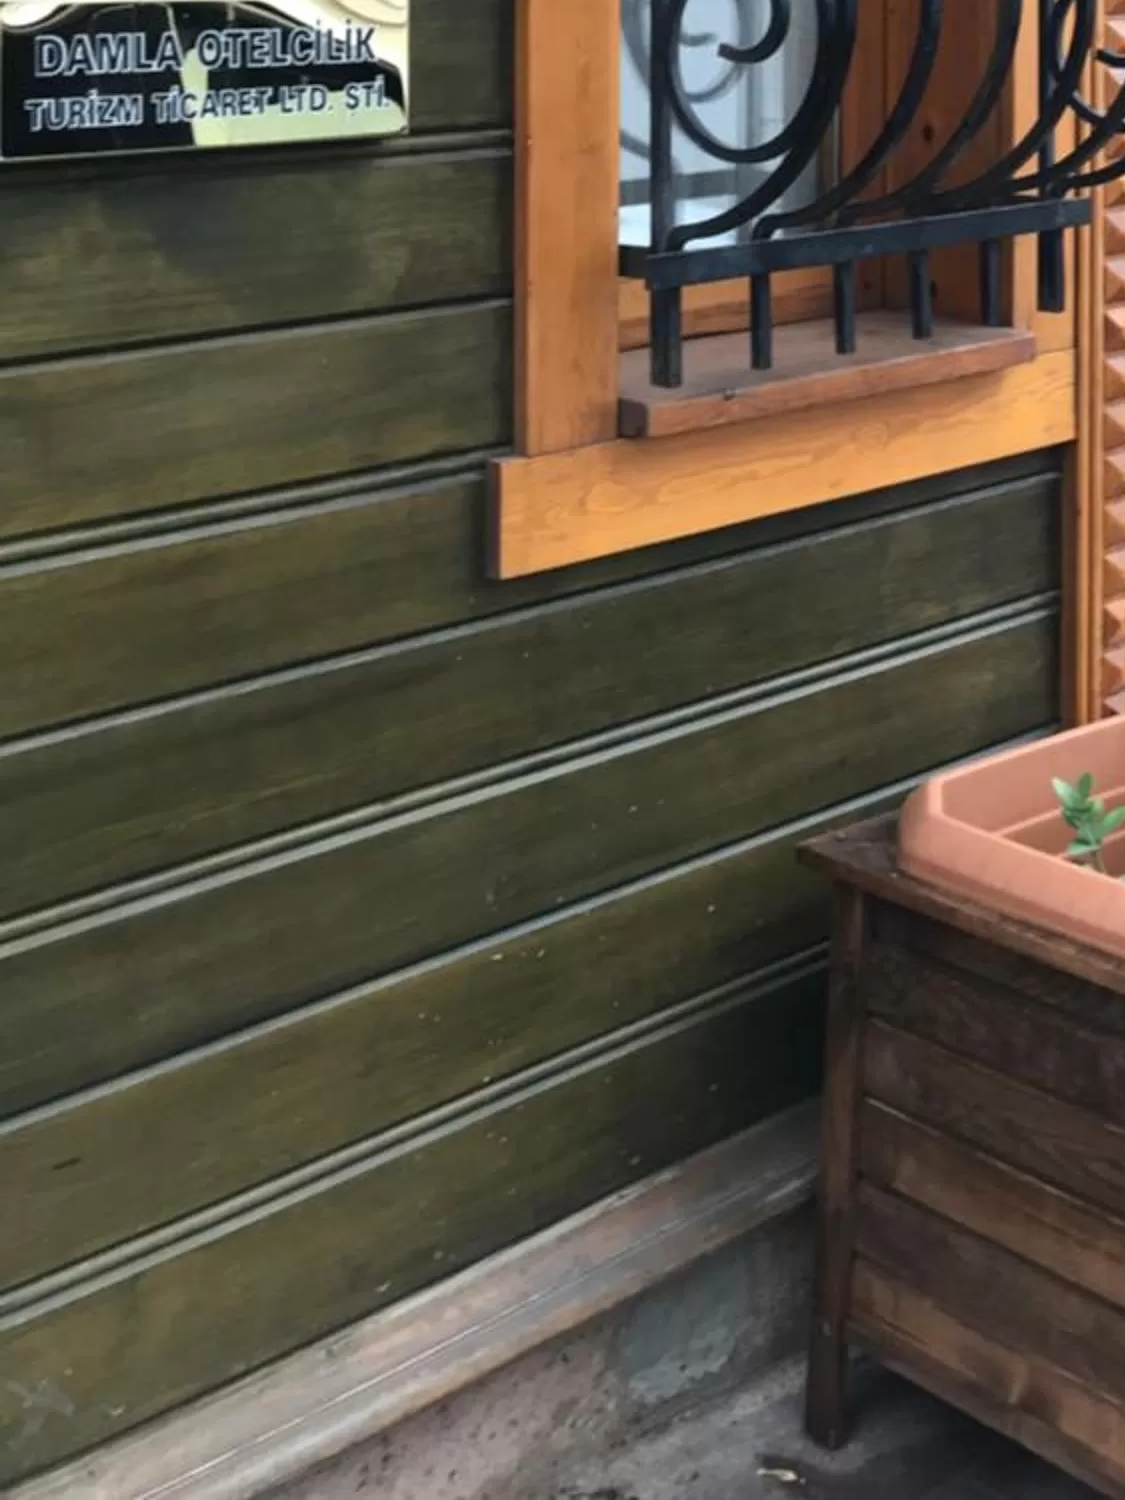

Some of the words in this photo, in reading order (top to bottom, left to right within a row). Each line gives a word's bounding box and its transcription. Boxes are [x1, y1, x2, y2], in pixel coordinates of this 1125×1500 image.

[34, 30, 184, 78] DAMLA
[196, 19, 378, 70] OTELCİLİK
[23, 88, 144, 132] TURİZM
[151, 84, 275, 126] TİCARET
